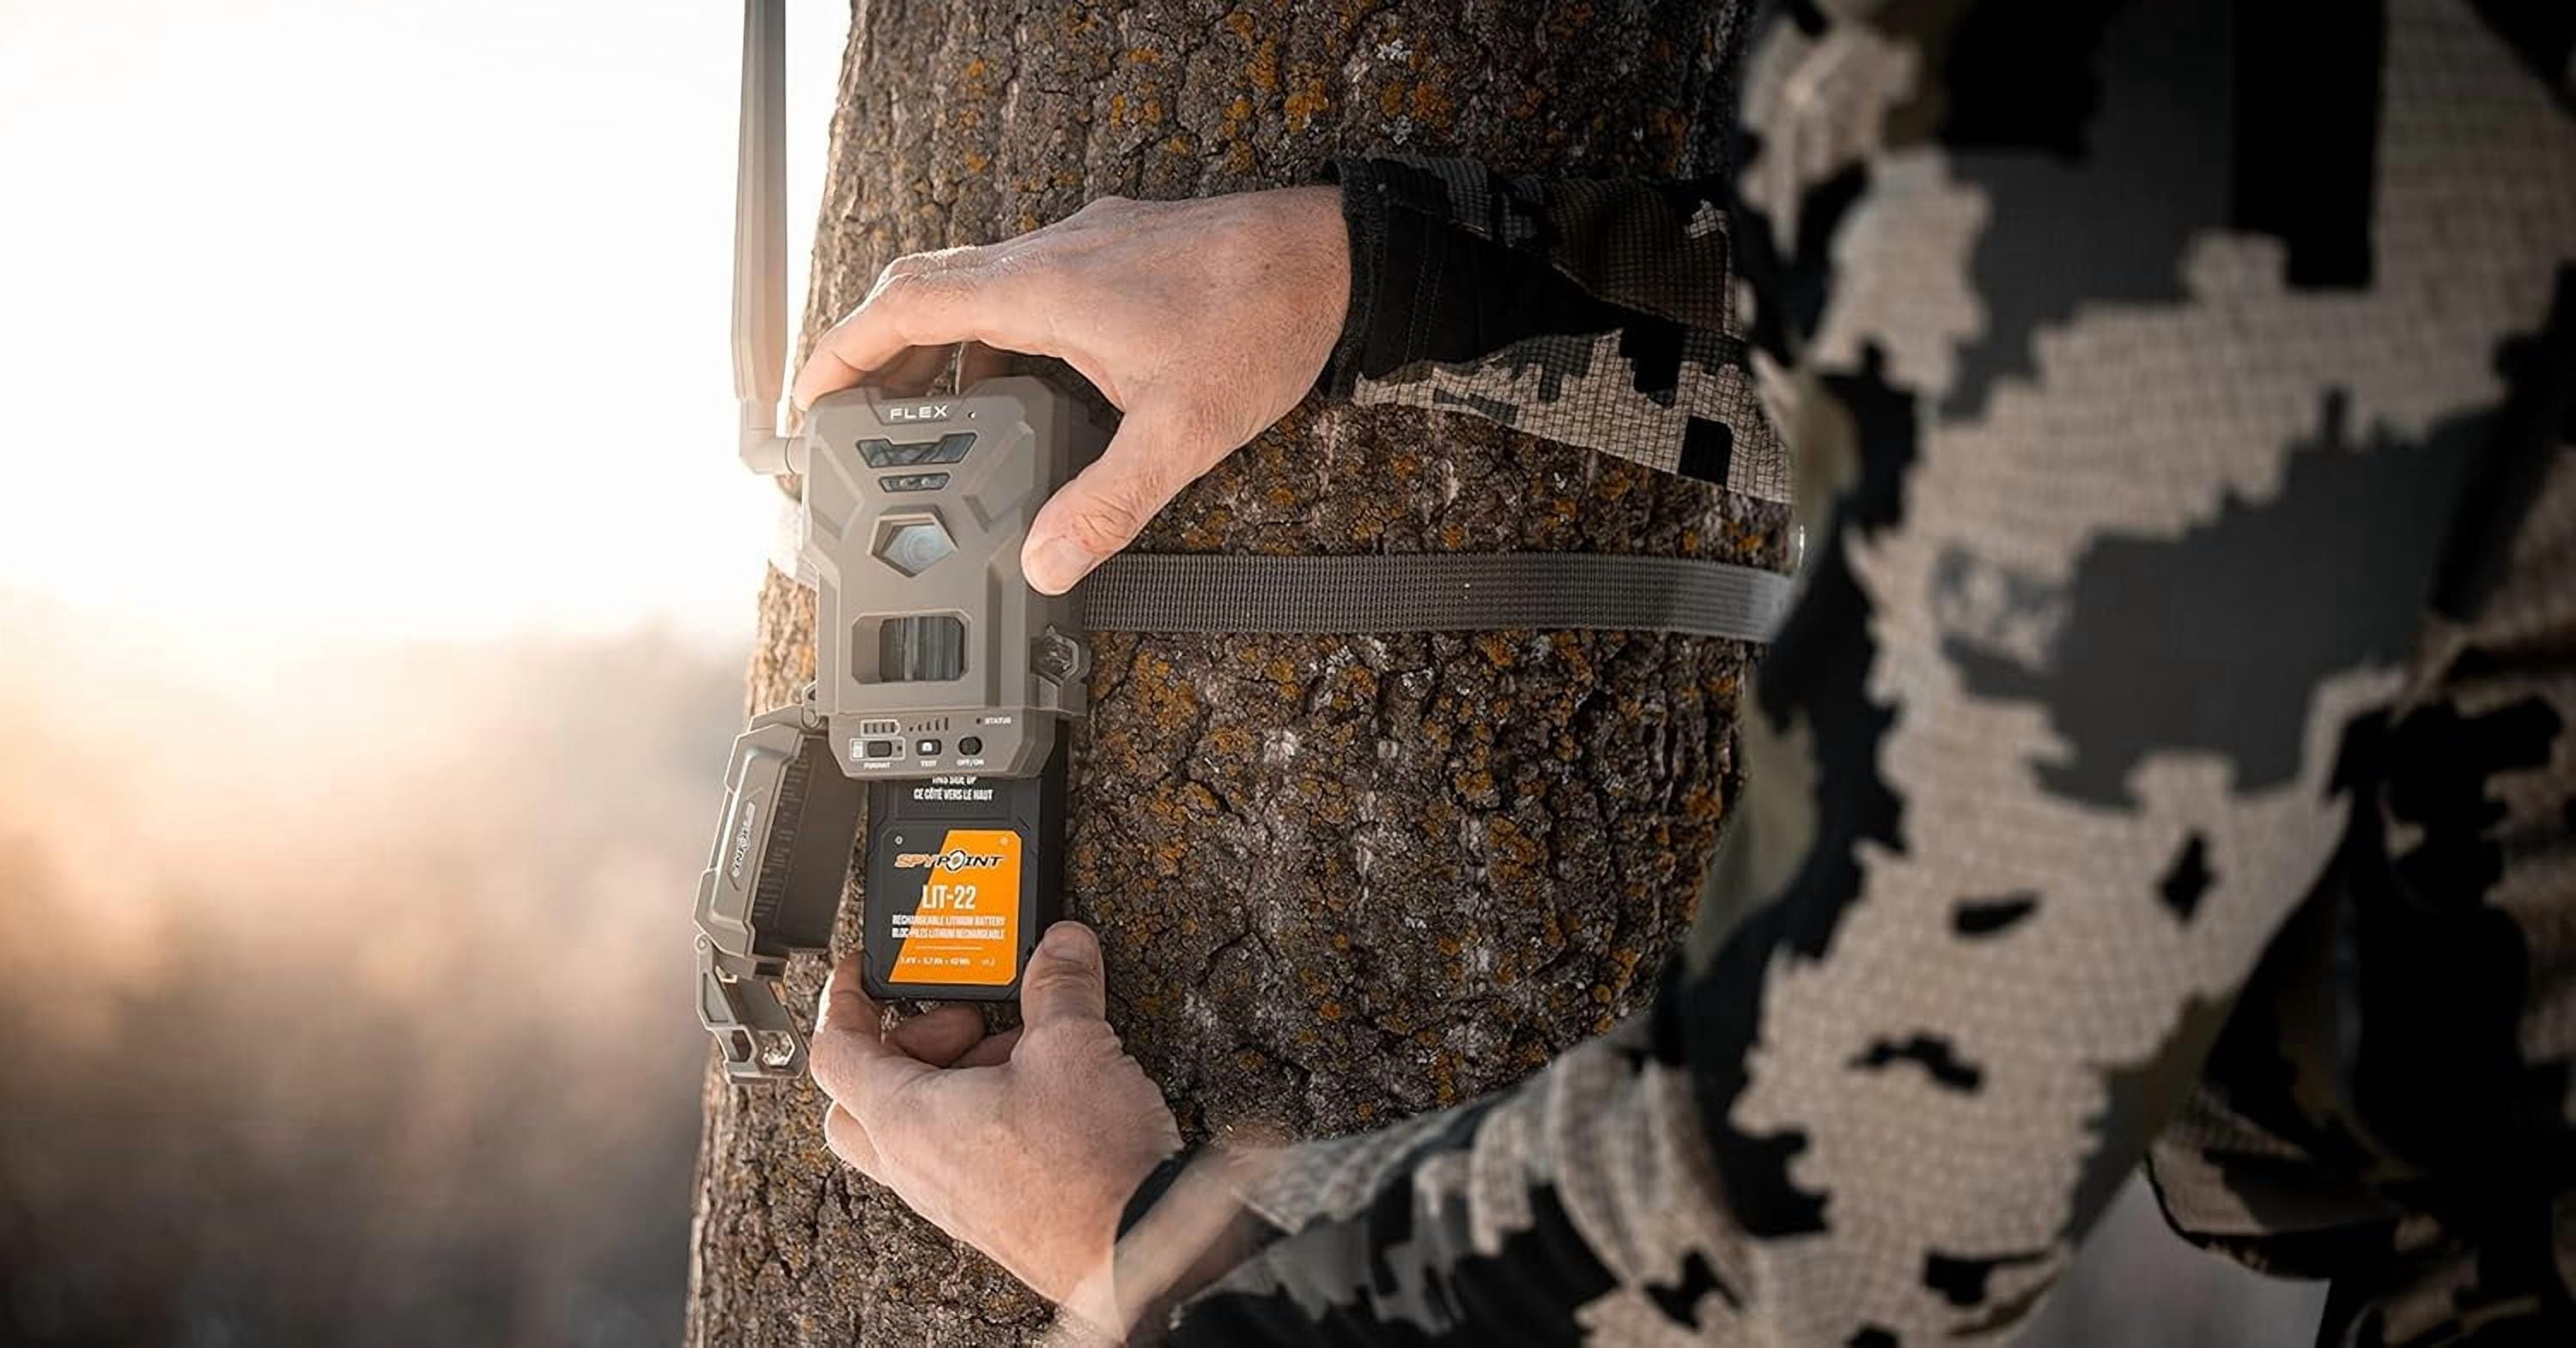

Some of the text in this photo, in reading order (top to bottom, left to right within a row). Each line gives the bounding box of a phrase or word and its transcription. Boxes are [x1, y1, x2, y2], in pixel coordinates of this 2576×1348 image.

[890, 404, 948, 421] FLEX
[913, 788, 924, 799] CE
[944, 789, 963, 800] VERS
[963, 789, 972, 800] LE
[973, 789, 993, 801] HAUT
[894, 849, 1004, 873] SPYPOINT
[921, 884, 977, 910] LIT-22
